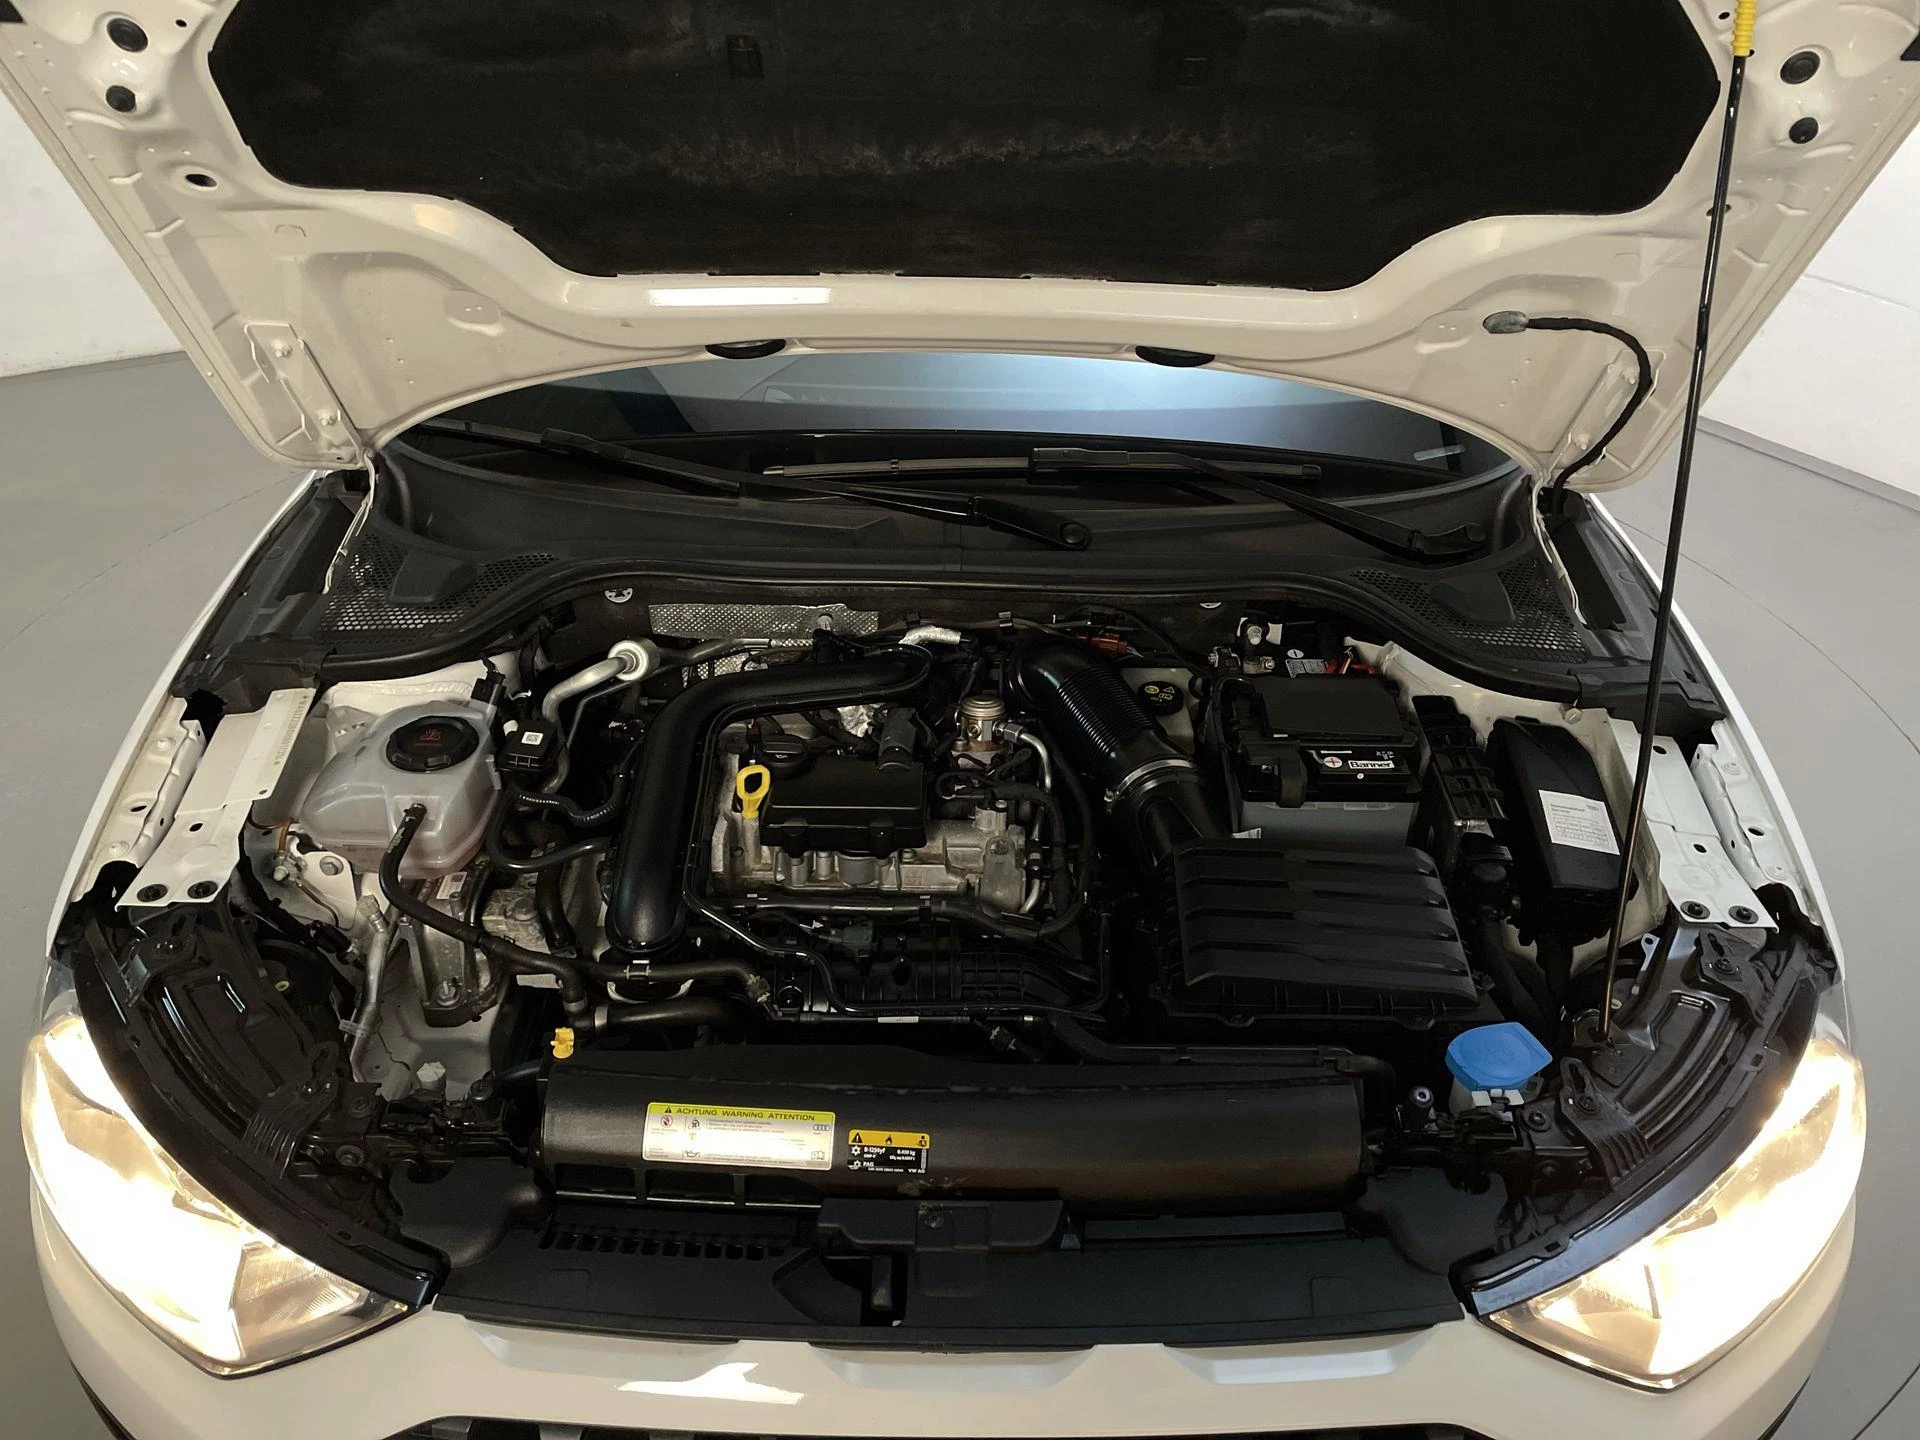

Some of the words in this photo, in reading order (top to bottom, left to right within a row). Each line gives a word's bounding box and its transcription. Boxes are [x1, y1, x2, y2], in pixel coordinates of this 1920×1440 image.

[676, 1107, 717, 1116] ACHTUNG
[722, 1110, 764, 1119] WARNING
[768, 1112, 815, 1121] ATTENTION
